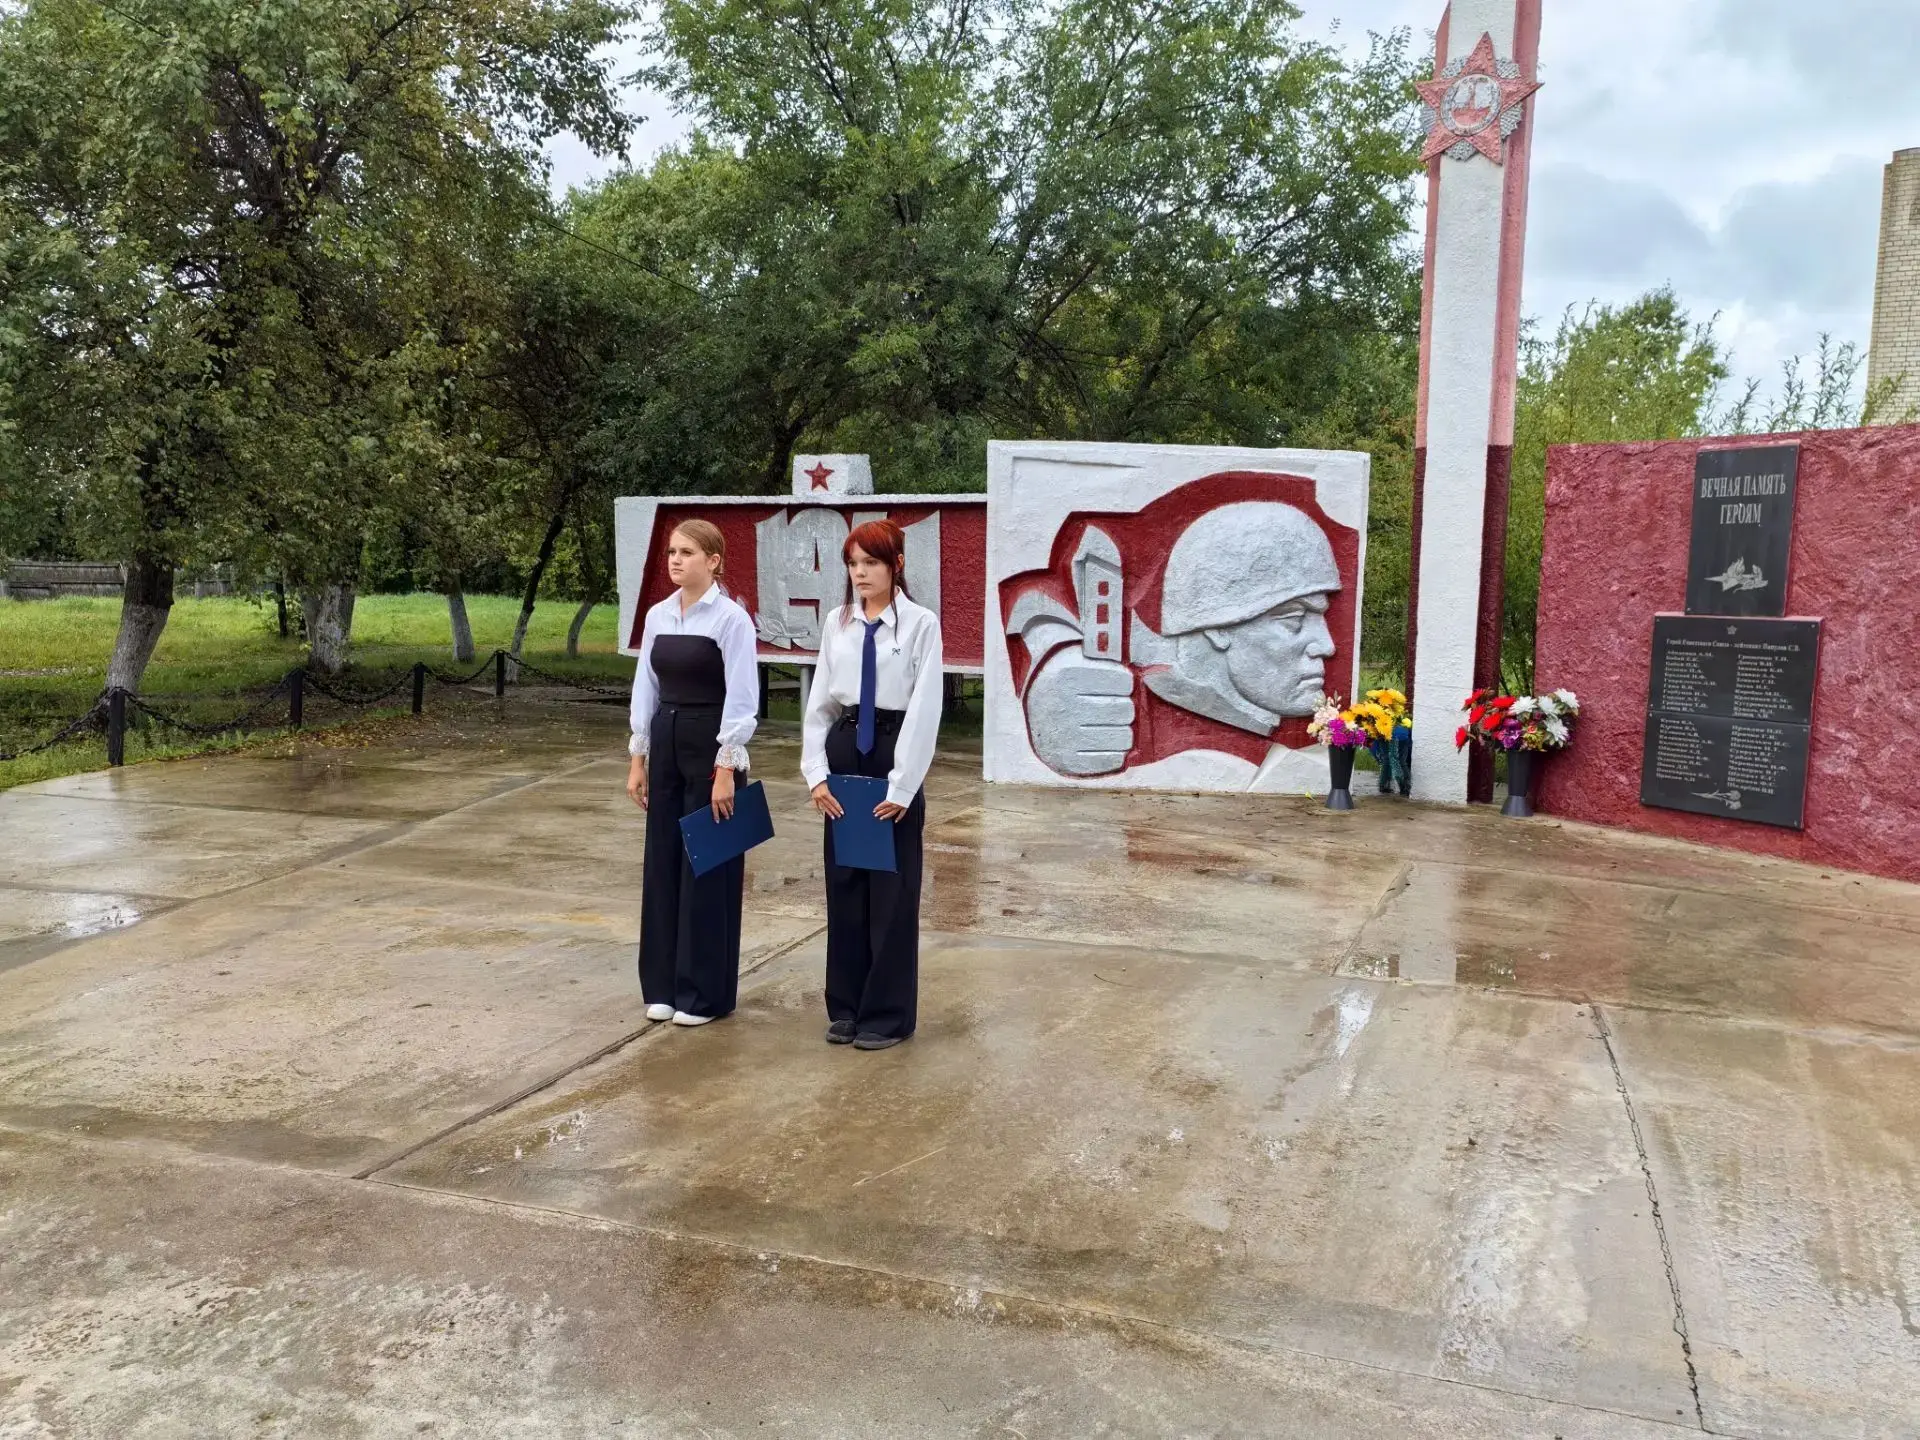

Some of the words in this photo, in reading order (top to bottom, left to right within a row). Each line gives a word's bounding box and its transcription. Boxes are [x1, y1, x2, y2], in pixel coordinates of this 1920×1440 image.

[1700, 476, 1741, 499] ВЕЧНАЯ
[1743, 474, 1787, 496] ПАМЯТЬ
[1720, 503, 1762, 525] ГЕРОЯМ
